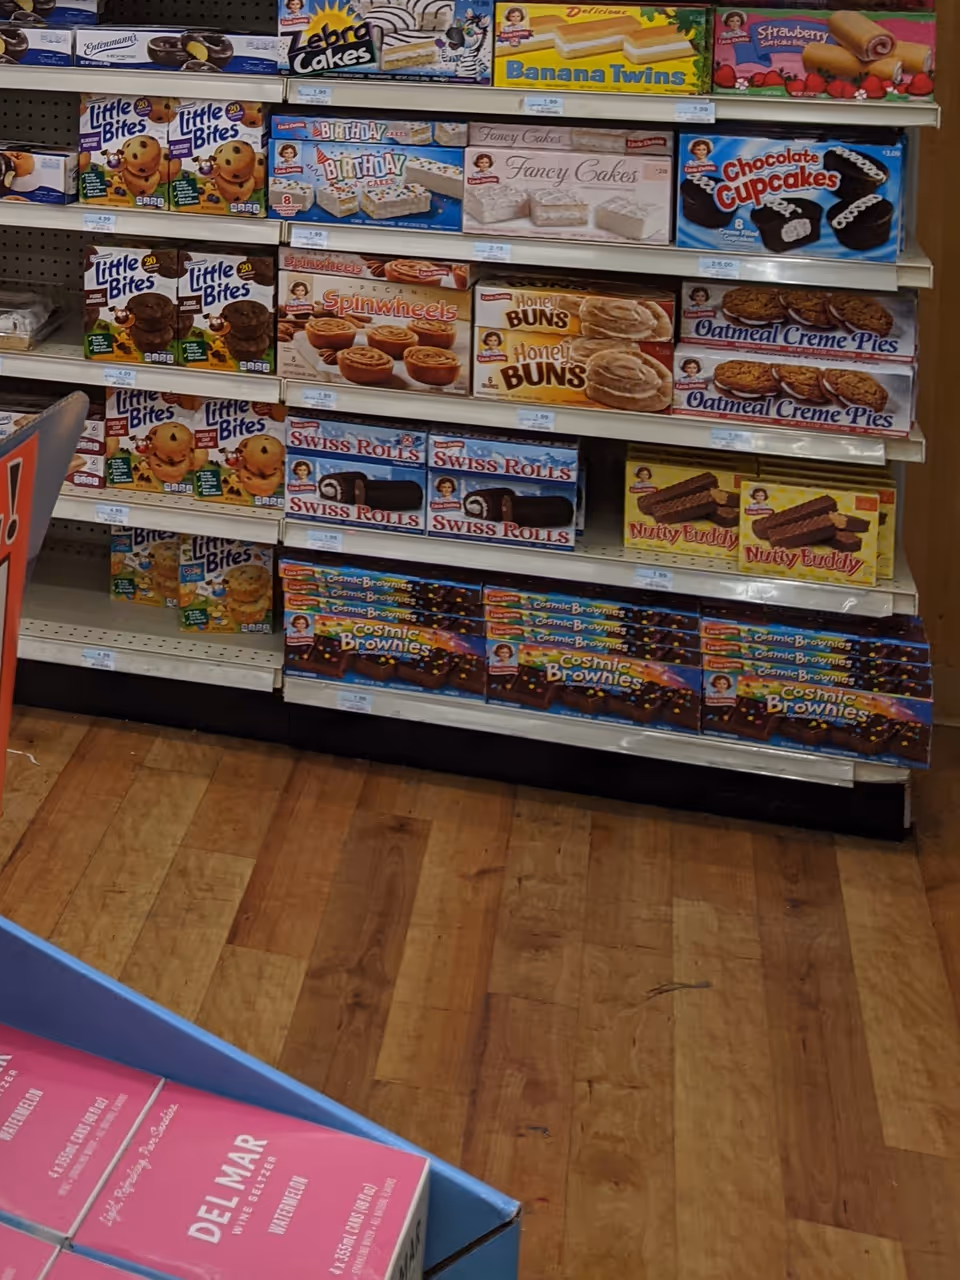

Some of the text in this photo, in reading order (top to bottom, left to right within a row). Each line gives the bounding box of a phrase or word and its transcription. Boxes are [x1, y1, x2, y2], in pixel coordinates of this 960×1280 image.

[83, 33, 138, 55] Entenmann's
[281, 21, 373, 53] Zebra
[757, 24, 829, 43] Strawberry
[293, 43, 372, 73] Cakes
[506, 60, 685, 85] Banana Twins
[90, 98, 132, 131] Little
[179, 103, 223, 137] Little
[102, 119, 147, 143] Bites
[193, 124, 239, 150] Bites
[479, 125, 562, 145] Fancy Cakes
[325, 153, 407, 181] BIRTHDAY
[506, 156, 637, 187] Fancy Cakes
[723, 149, 819, 184] Chocolate
[716, 170, 839, 210] Cupcakes
[95, 255, 139, 287] Little
[189, 261, 234, 293] Little
[109, 275, 155, 300] Bites
[203, 283, 250, 306] Bites
[323, 291, 459, 320] Spinwheels
[516, 295, 560, 309] Honey
[506, 309, 570, 329] BUNS
[695, 318, 898, 353] Oatmeal Creme Pies
[513, 343, 572, 366] Honey
[500, 364, 589, 391] BUNS
[130, 406, 174, 428] Bites
[687, 390, 893, 429] Oatmeal Creme Pies
[219, 419, 265, 441] Bites
[291, 431, 420, 461] SWISS ROLLS
[434, 451, 571, 481] SWISS ROLLS
[291, 498, 419, 527] SWISS ROLLS
[432, 515, 569, 544] SWISS ROLLS
[629, 523, 738, 551] Nutty Buddy
[206, 549, 252, 573] Bites
[745, 546, 863, 576] Nutty Buddy
[340, 633, 432, 656] Brownies
[353, 623, 418, 640] Cosmic
[558, 653, 630, 672] Cosmic
[546, 663, 644, 691] Brownies
[765, 695, 869, 721] Brownies
[781, 686, 856, 705] Cosmic
[187, 1133, 269, 1245] DEL MAR
[231, 1155, 278, 1235] WINE SELTZER
[267, 1174, 309, 1235] WATERMELON
